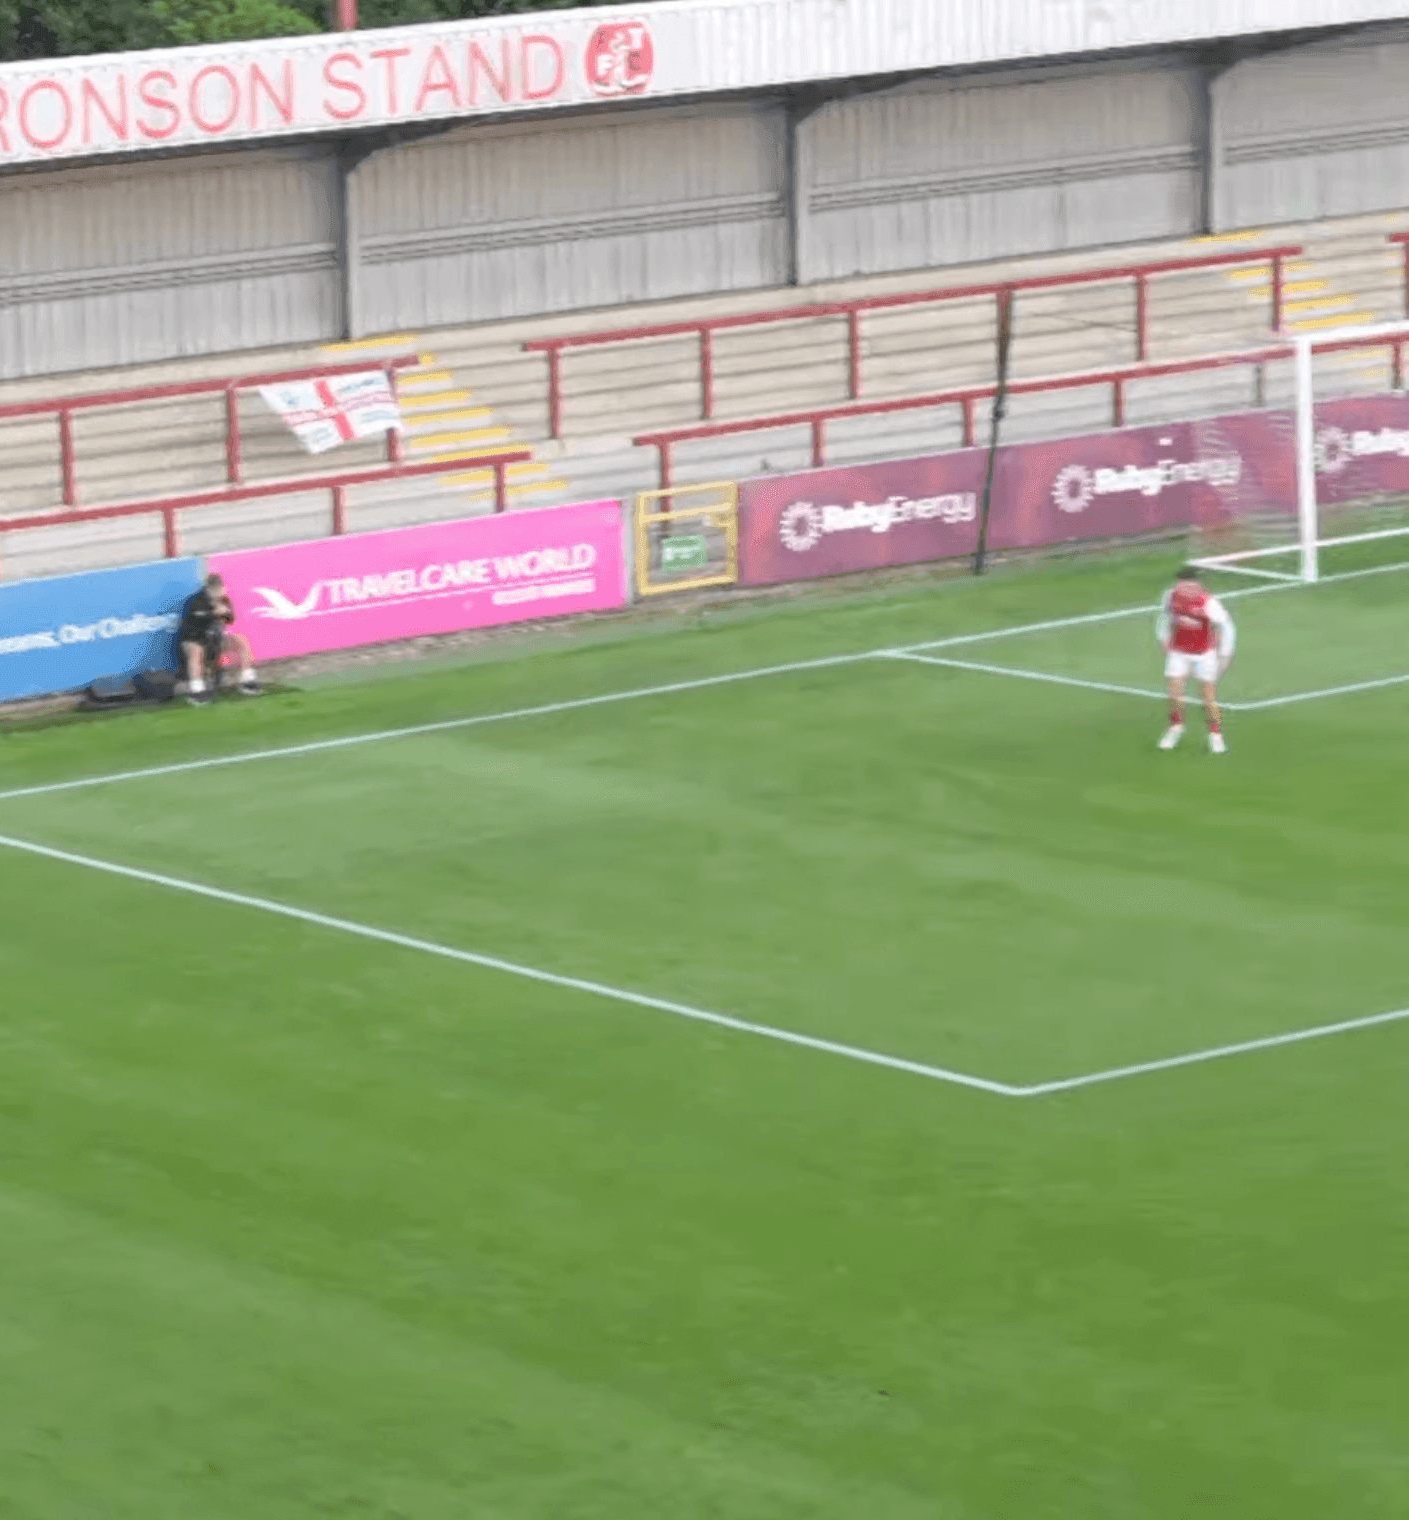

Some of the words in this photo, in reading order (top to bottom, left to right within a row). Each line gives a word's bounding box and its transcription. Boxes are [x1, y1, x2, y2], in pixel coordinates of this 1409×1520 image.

[321, 33, 566, 121] STAND
[821, 492, 977, 533] RubyEnergy
[327, 558, 493, 605] TRAVELCARE
[491, 543, 596, 580] WORLD
[58, 623, 96, 643] Our
[96, 613, 179, 638] Challeng
